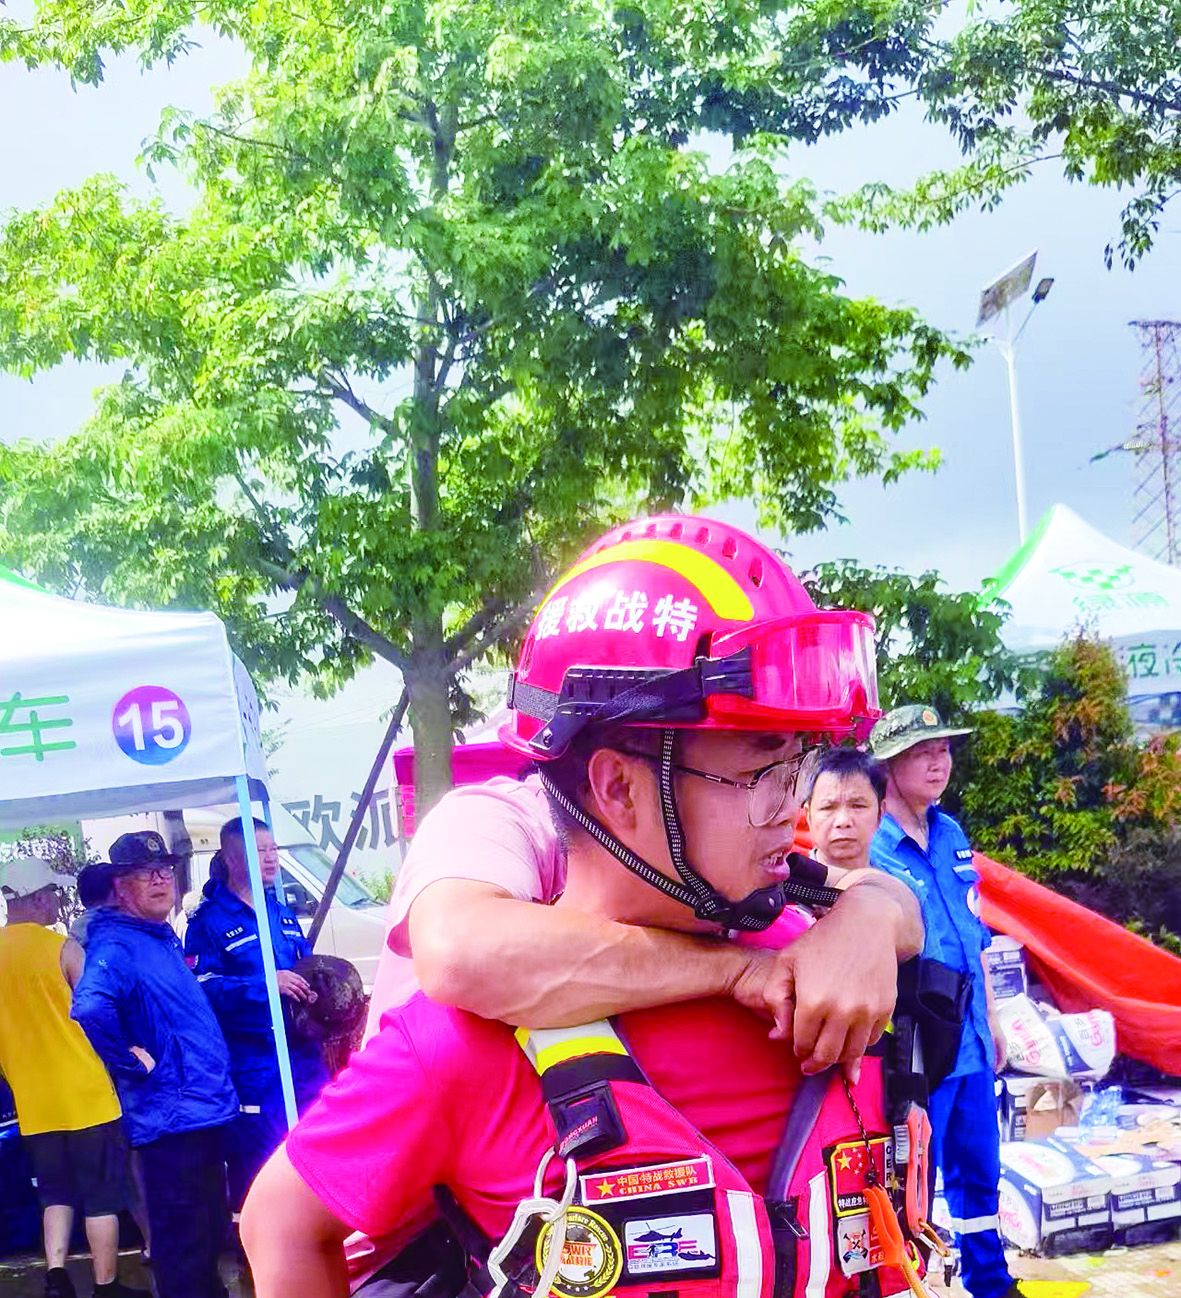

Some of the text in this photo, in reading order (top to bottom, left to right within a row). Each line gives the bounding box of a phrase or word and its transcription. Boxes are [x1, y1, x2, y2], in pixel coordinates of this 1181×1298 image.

[0, 691, 76, 761] 车
[118, 701, 185, 751] 15
[619, 1183, 662, 1195] CHINA
